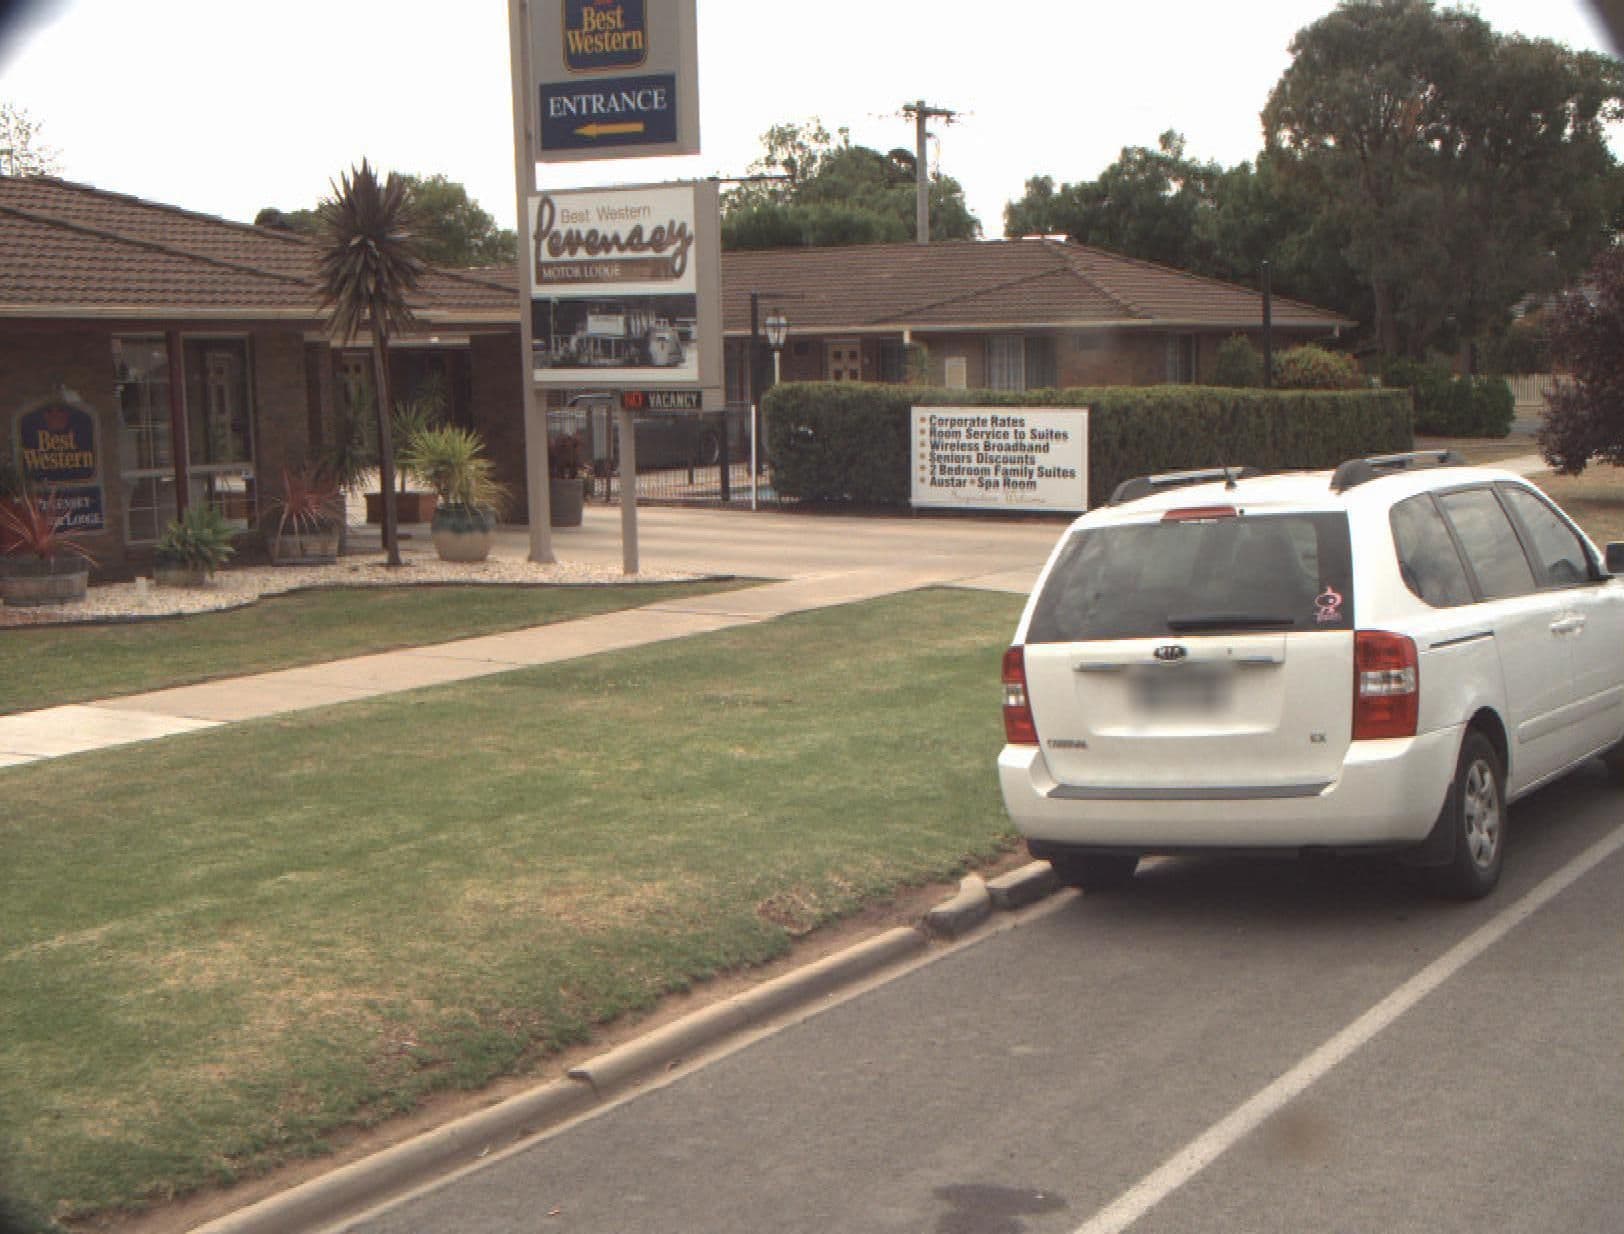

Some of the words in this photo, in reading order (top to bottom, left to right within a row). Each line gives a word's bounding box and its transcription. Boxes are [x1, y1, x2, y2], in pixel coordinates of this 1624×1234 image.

[582, 6, 625, 32] Best
[567, 28, 644, 54] Western
[549, 87, 668, 118] ENTRANCE
[560, 208, 591, 224] Best
[596, 204, 651, 223] Western
[542, 265, 582, 280] MOTOR
[584, 264, 624, 278] LODGE
[649, 391, 698, 408] VACANCY
[929, 415, 988, 429] Corporate
[991, 416, 1026, 428] Rates
[38, 430, 75, 450] Best
[929, 428, 962, 440] Room
[965, 428, 1010, 441] Service
[1014, 428, 1026, 440] to
[1030, 429, 1070, 442] Suites
[929, 441, 980, 453] Wireless
[983, 441, 1050, 455] Broadband
[24, 448, 96, 470] Western
[929, 452, 973, 465] Seniors
[976, 453, 1036, 467] Discounts
[929, 465, 936, 477] 2
[939, 464, 991, 477] Bedroom
[994, 465, 1034, 480] Family
[1037, 466, 1077, 479] Suites
[929, 477, 968, 489] Austar
[977, 477, 1000, 491] Spa
[1003, 478, 1037, 490] Room
[1155, 646, 1187, 660] KIA
